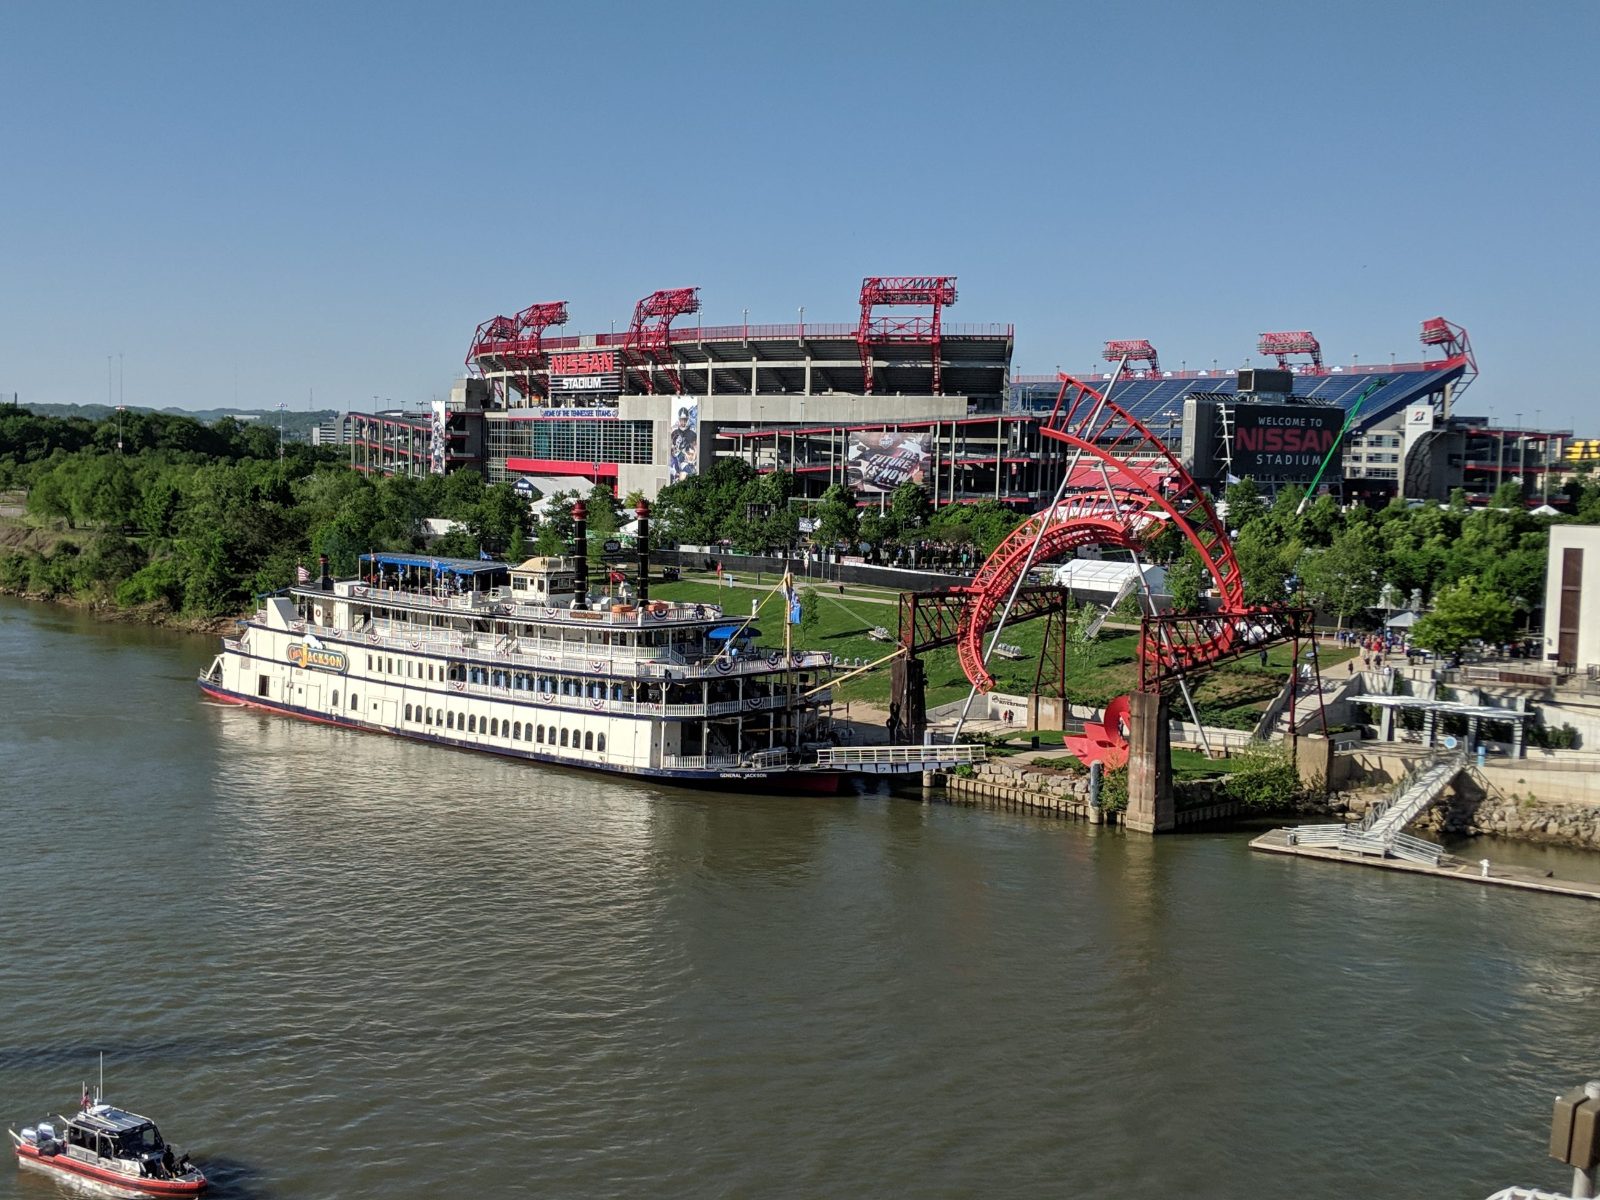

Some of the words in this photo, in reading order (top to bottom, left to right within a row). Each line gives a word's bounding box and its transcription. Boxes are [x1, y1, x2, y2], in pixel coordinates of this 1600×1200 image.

[551, 352, 614, 375] NISSAN
[562, 377, 602, 389] STADIUM
[1258, 416, 1306, 427] WELCOME
[1310, 418, 1324, 427] TO
[1235, 427, 1341, 453] NISSAN
[869, 453, 912, 469] FUTURE
[897, 450, 919, 460] THE
[1256, 454, 1321, 466] STADIUM
[866, 464, 880, 478] IS
[878, 467, 912, 484] NOW
[299, 643, 343, 668] JACKSON
